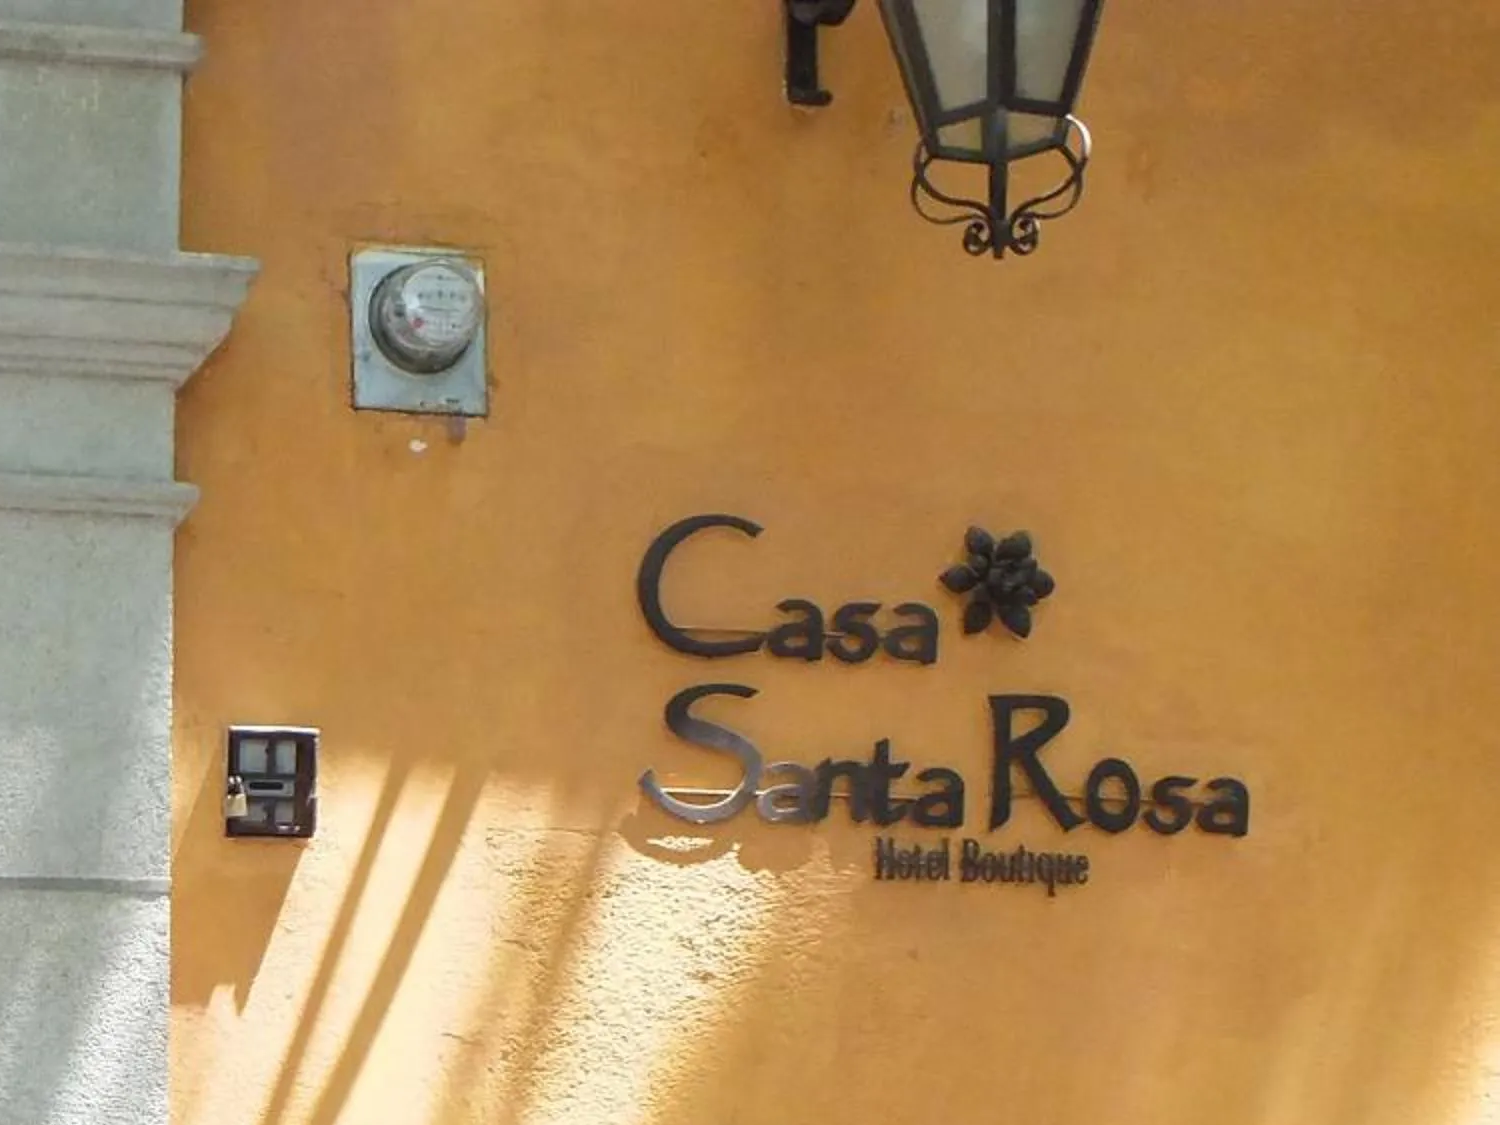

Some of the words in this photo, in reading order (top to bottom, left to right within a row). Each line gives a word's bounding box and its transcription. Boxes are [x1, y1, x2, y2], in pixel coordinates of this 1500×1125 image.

[636, 513, 939, 665] Casa
[637, 683, 965, 828] Santa
[987, 694, 1250, 836] Rosa
[874, 836, 950, 882] Hotel
[959, 838, 1090, 897] Boutique
